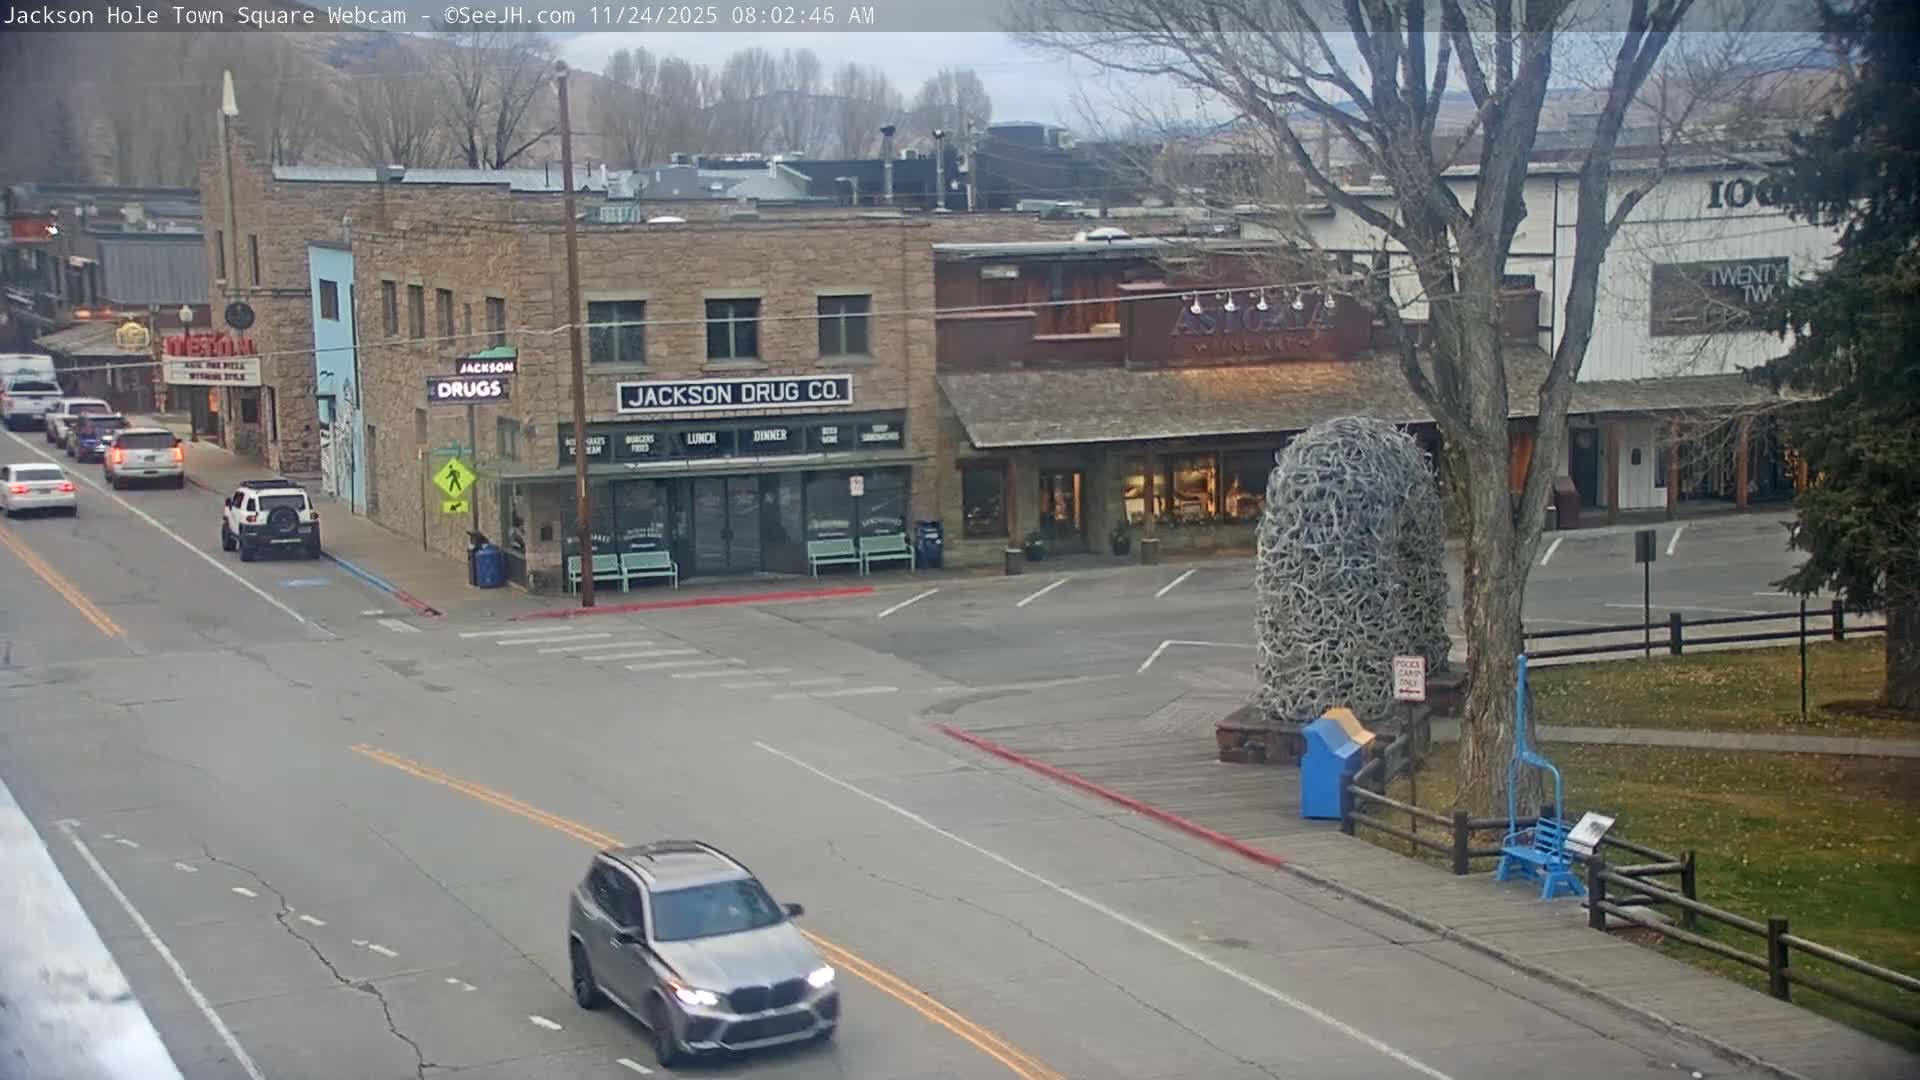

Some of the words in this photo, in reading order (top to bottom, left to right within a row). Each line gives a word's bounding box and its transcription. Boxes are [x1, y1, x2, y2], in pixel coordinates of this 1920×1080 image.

[1712, 264, 1785, 287] TWENTY
[460, 362, 514, 374] JACKSON
[437, 381, 502, 398] DRUGS
[628, 383, 733, 408] JACKSON
[741, 382, 799, 402] DRUG
[807, 380, 841, 400] CO.
[687, 431, 717, 445] LUNCH
[753, 429, 787, 442] DINNER
